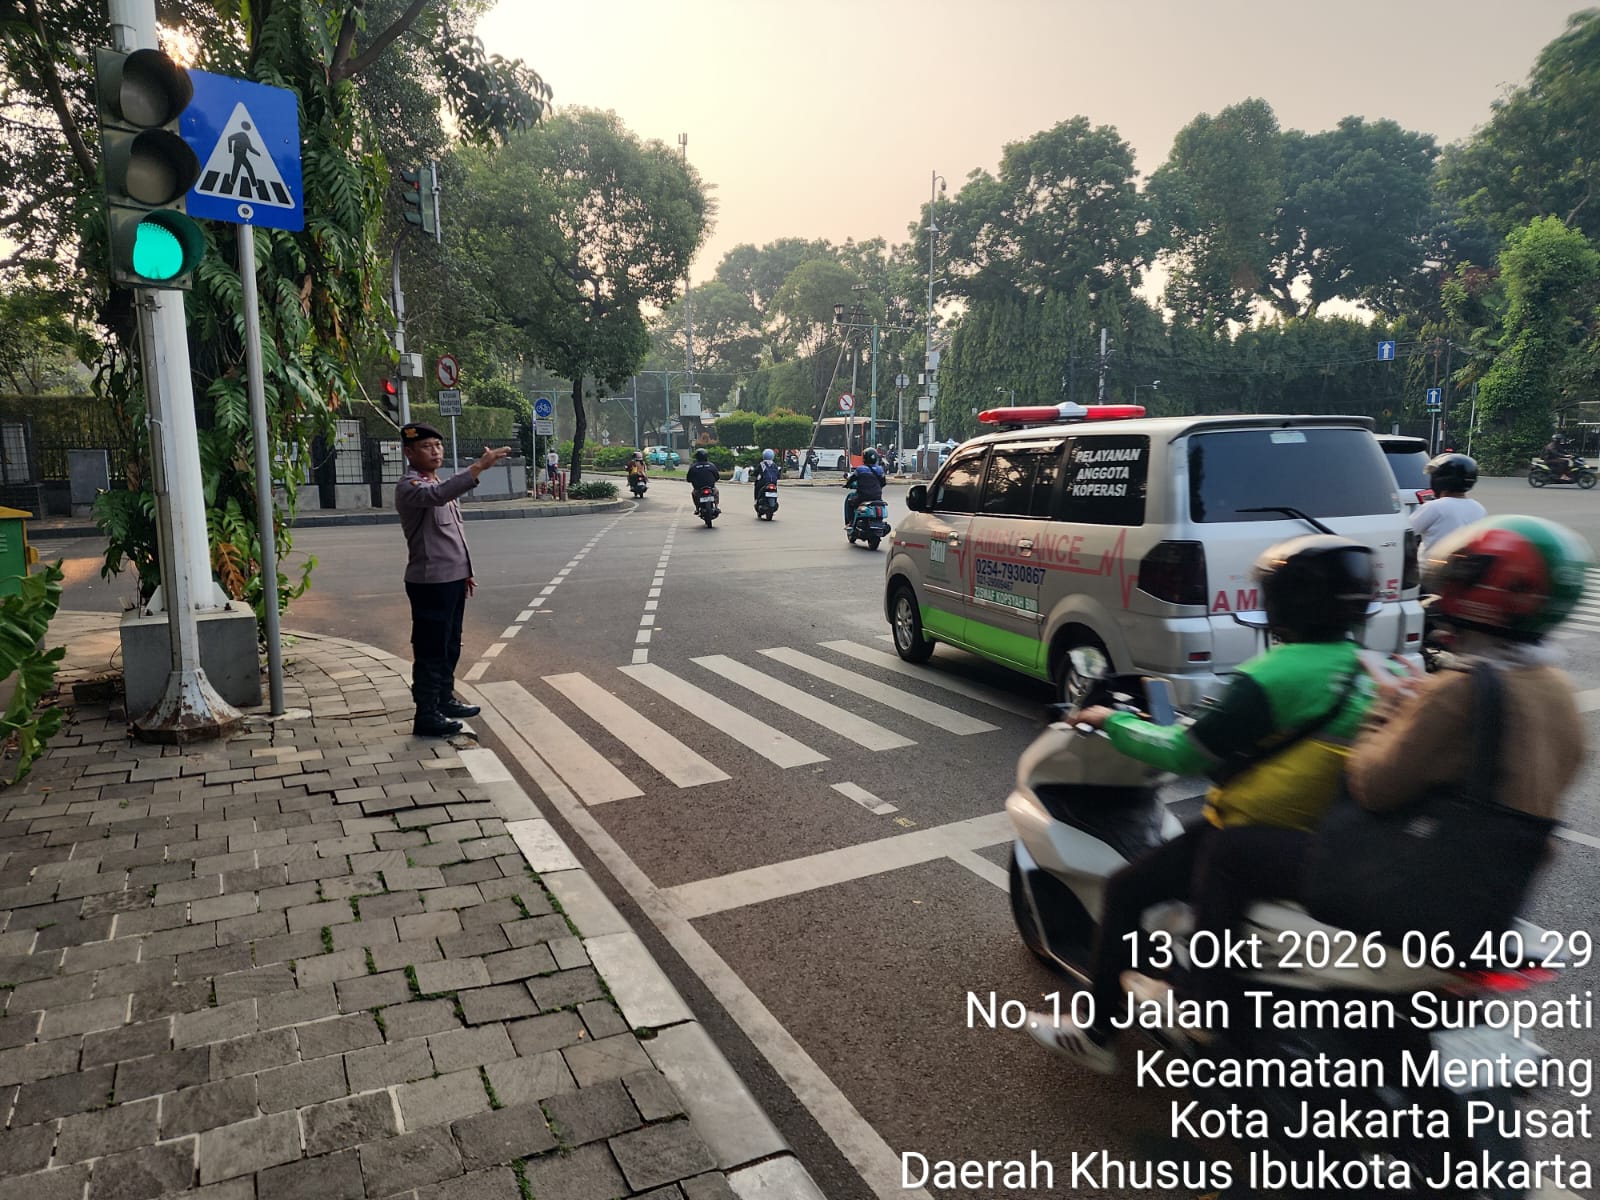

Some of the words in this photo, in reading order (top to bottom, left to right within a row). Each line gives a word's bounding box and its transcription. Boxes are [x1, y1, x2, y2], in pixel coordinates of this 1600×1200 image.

[1075, 449, 1141, 463] PELAYANAN
[1076, 466, 1129, 480] ANGGOTA
[1072, 484, 1127, 497] KOPERASI
[974, 527, 1085, 565] AMBUANCE
[976, 558, 1046, 585] 0254-7930867
